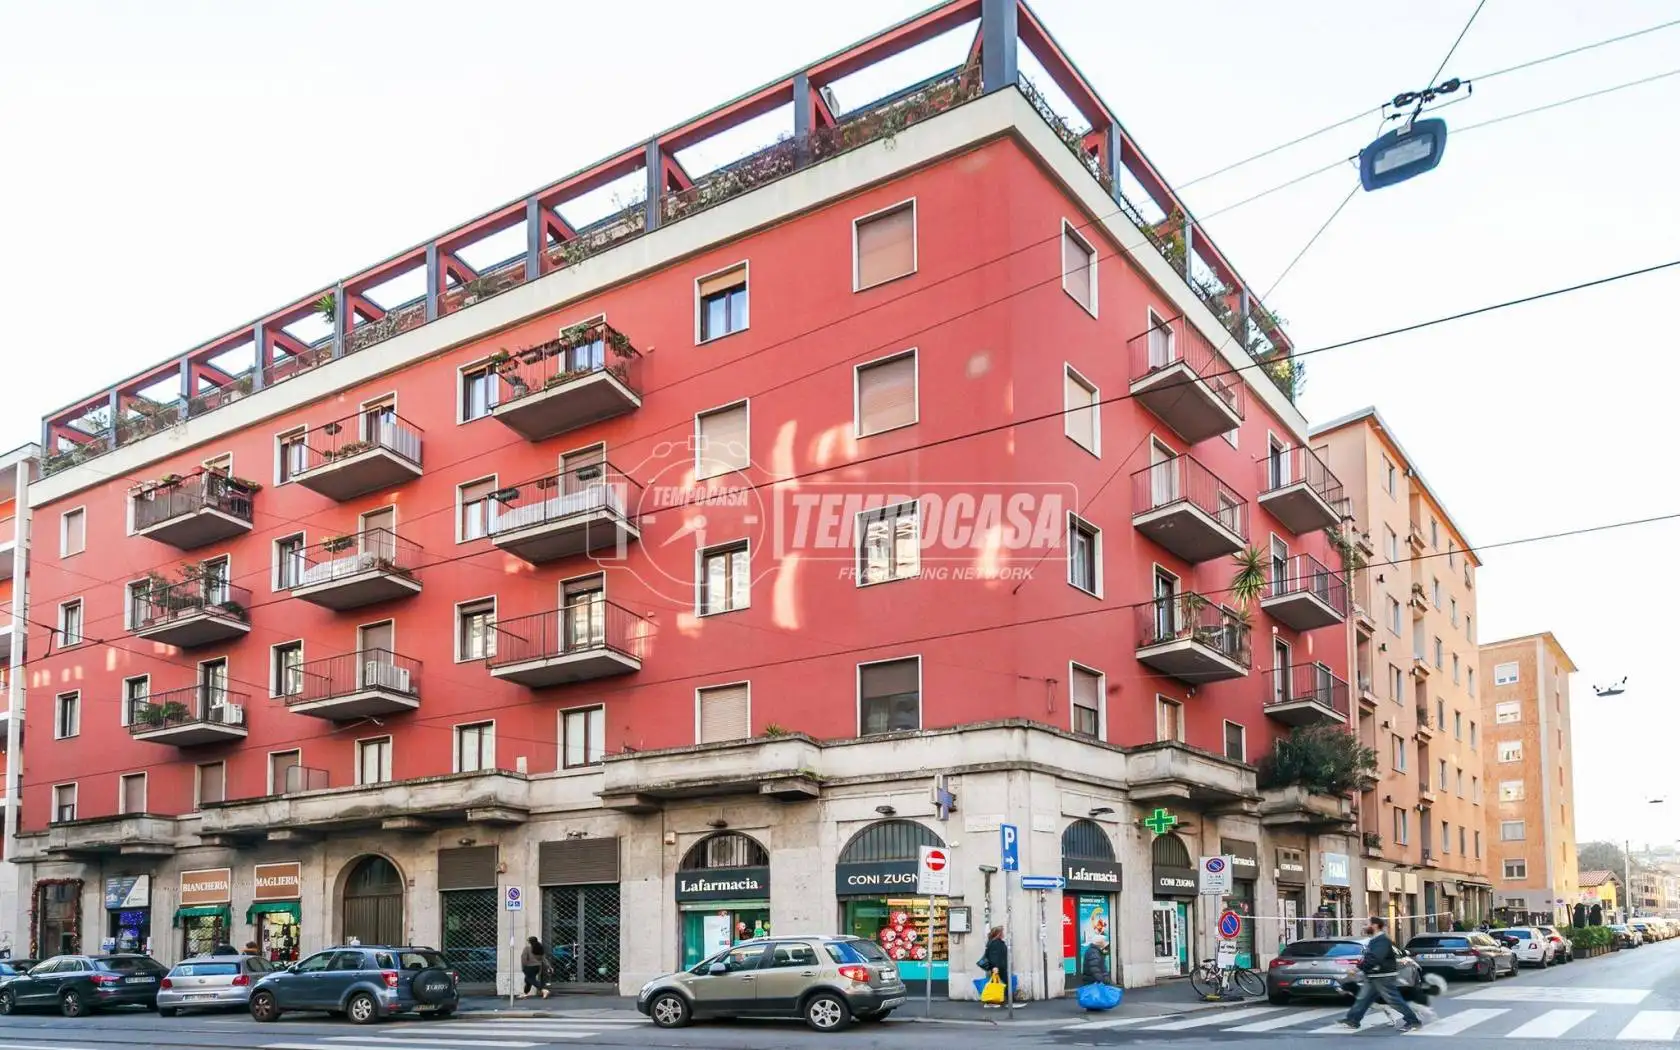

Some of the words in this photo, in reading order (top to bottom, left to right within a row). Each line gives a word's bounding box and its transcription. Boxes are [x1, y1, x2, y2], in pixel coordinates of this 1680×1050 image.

[1004, 827, 1015, 850] P
[255, 875, 299, 887] MAGLIERIA
[847, 875, 880, 886] CONI
[884, 873, 919, 885] ZUGN
[1160, 877, 1175, 887] CONI
[182, 880, 229, 892] BIANCHERIA
